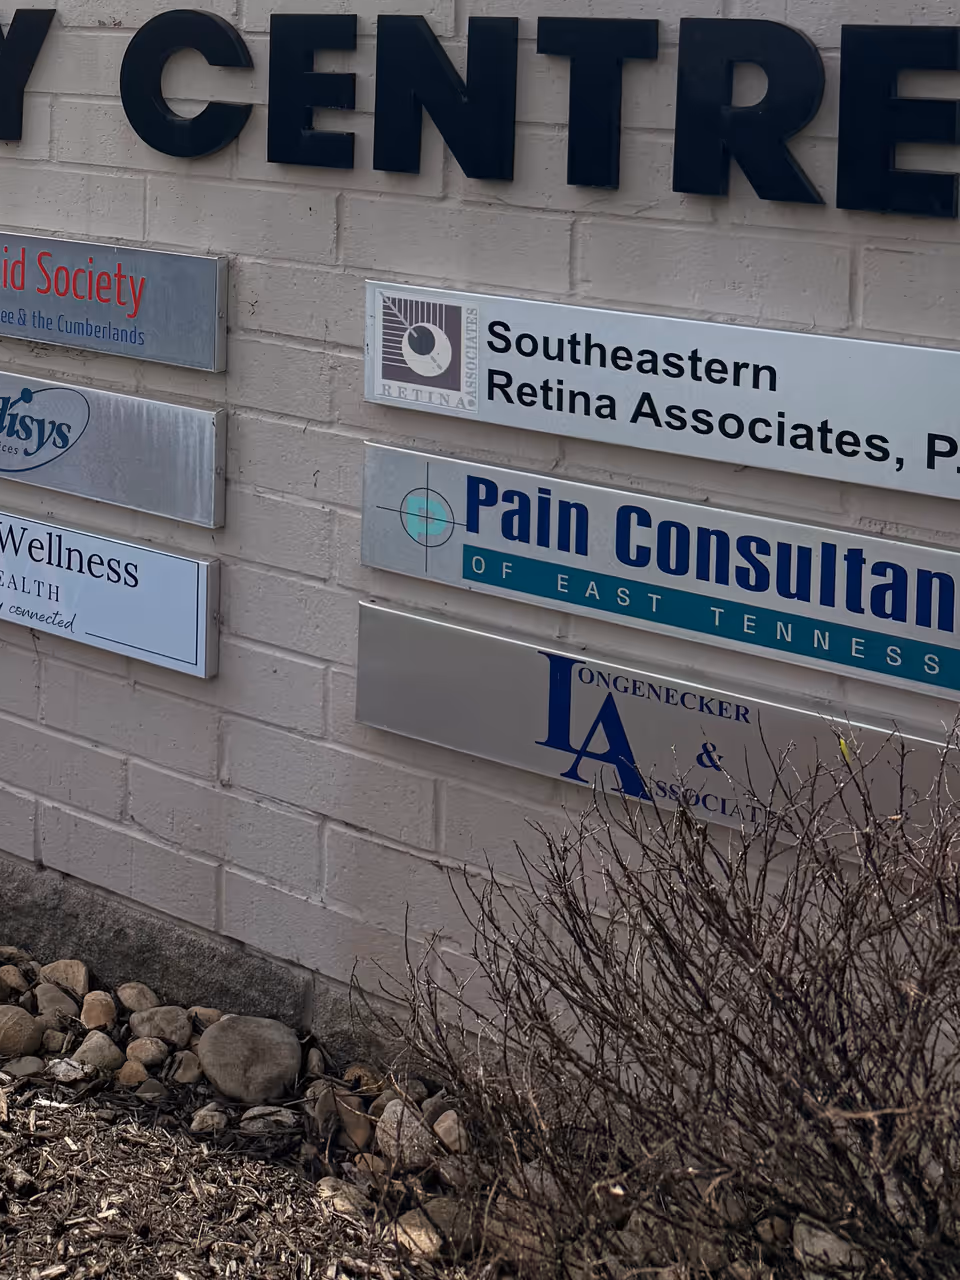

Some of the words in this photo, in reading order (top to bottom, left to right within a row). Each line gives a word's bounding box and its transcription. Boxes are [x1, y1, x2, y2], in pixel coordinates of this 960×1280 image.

[119, 9, 960, 218] CENTRE
[36, 251, 146, 319] Society
[18, 309, 27, 326] &
[31, 310, 52, 330] the
[57, 314, 145, 346] Cumberlands
[465, 308, 478, 400] ASSOCIATES
[486, 320, 778, 392] Southeastern
[381, 383, 467, 410] RETINA
[486, 368, 617, 421] Retina
[629, 392, 906, 473] Associates,
[465, 474, 589, 556] Pain
[614, 504, 957, 634] Consultan
[9, 604, 77, 633] connected
[471, 555, 514, 580] OF
[556, 574, 662, 614] EAST
[710, 606, 941, 675] TENNESS
[696, 740, 724, 772] &
